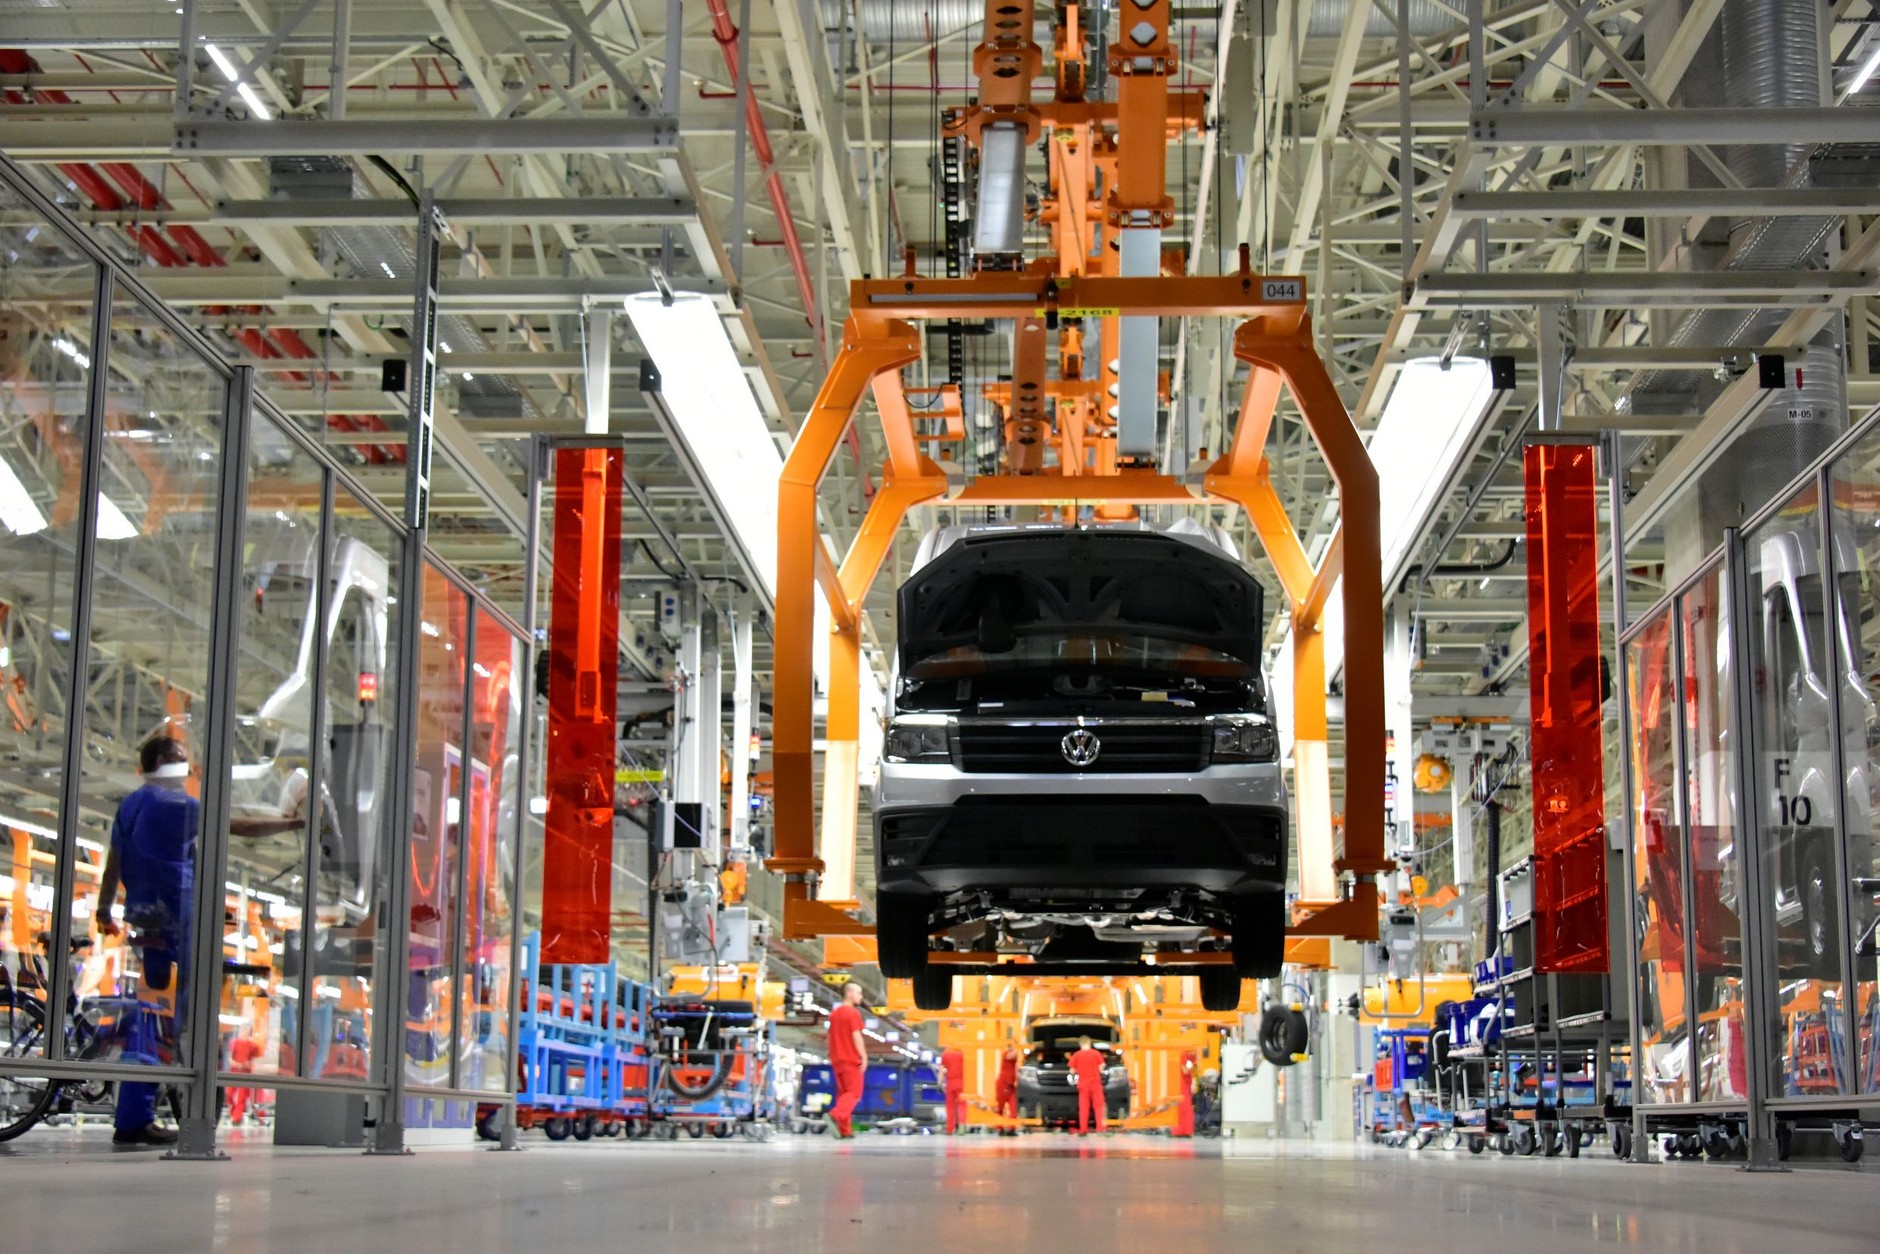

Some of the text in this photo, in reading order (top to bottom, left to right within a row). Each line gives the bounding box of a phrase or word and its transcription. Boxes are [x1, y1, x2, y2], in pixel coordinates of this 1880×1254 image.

[1267, 284, 1295, 297] 044
[1789, 410, 1811, 418] M-05
[1774, 759, 1789, 788] F
[1779, 795, 1811, 825] 10
